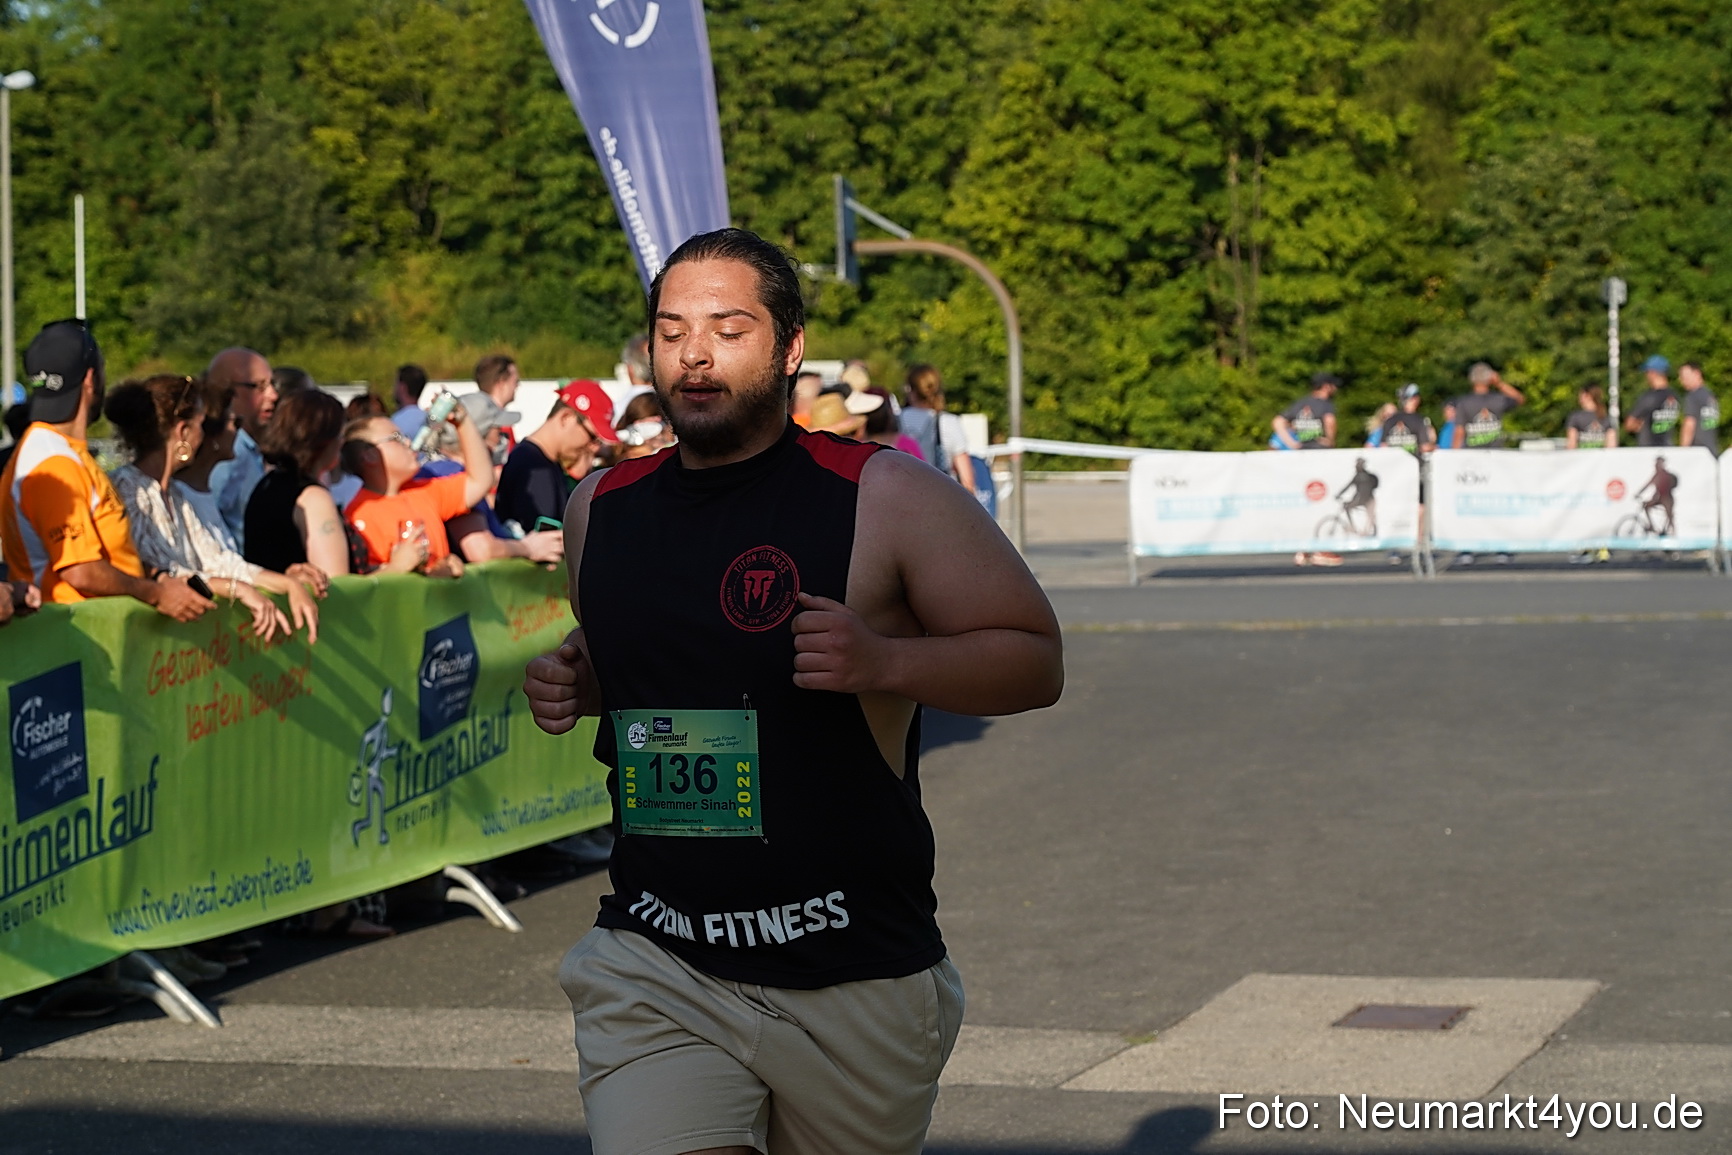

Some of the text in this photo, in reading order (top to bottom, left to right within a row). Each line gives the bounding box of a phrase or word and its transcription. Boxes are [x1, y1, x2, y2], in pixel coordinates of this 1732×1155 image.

[733, 551, 790, 573] TITAN FITNESS
[22, 711, 72, 749] Fischer
[395, 687, 517, 808] firmenlauf
[648, 732, 688, 743] Firmenlauf
[625, 766, 637, 809] RUN
[649, 753, 718, 795] 136
[736, 761, 752, 818] 2022
[636, 797, 737, 811] Schwemmer Sinah
[0, 754, 159, 899] irmenlauf
[0, 880, 65, 935] eumarkt
[703, 891, 850, 948] FITNESS
